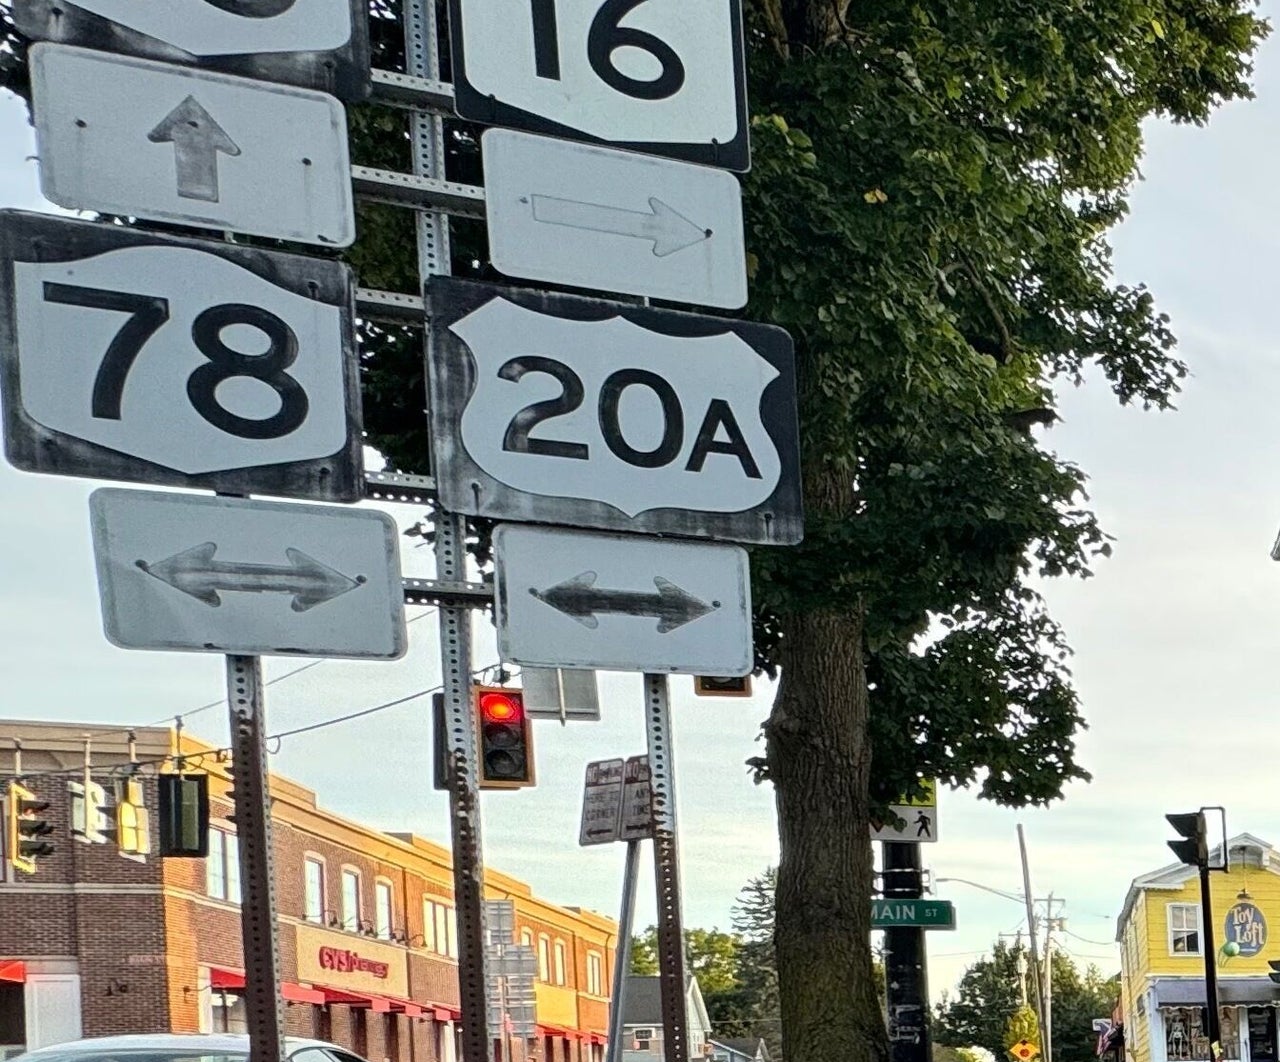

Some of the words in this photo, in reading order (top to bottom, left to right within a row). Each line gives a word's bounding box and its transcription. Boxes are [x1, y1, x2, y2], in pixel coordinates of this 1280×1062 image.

[531, 0, 686, 101] 16
[41, 280, 311, 441] 78
[496, 354, 763, 480] 20A
[925, 908, 938, 917] ST
[1232, 906, 1255, 930] Toy
[1234, 921, 1265, 947] Loft
